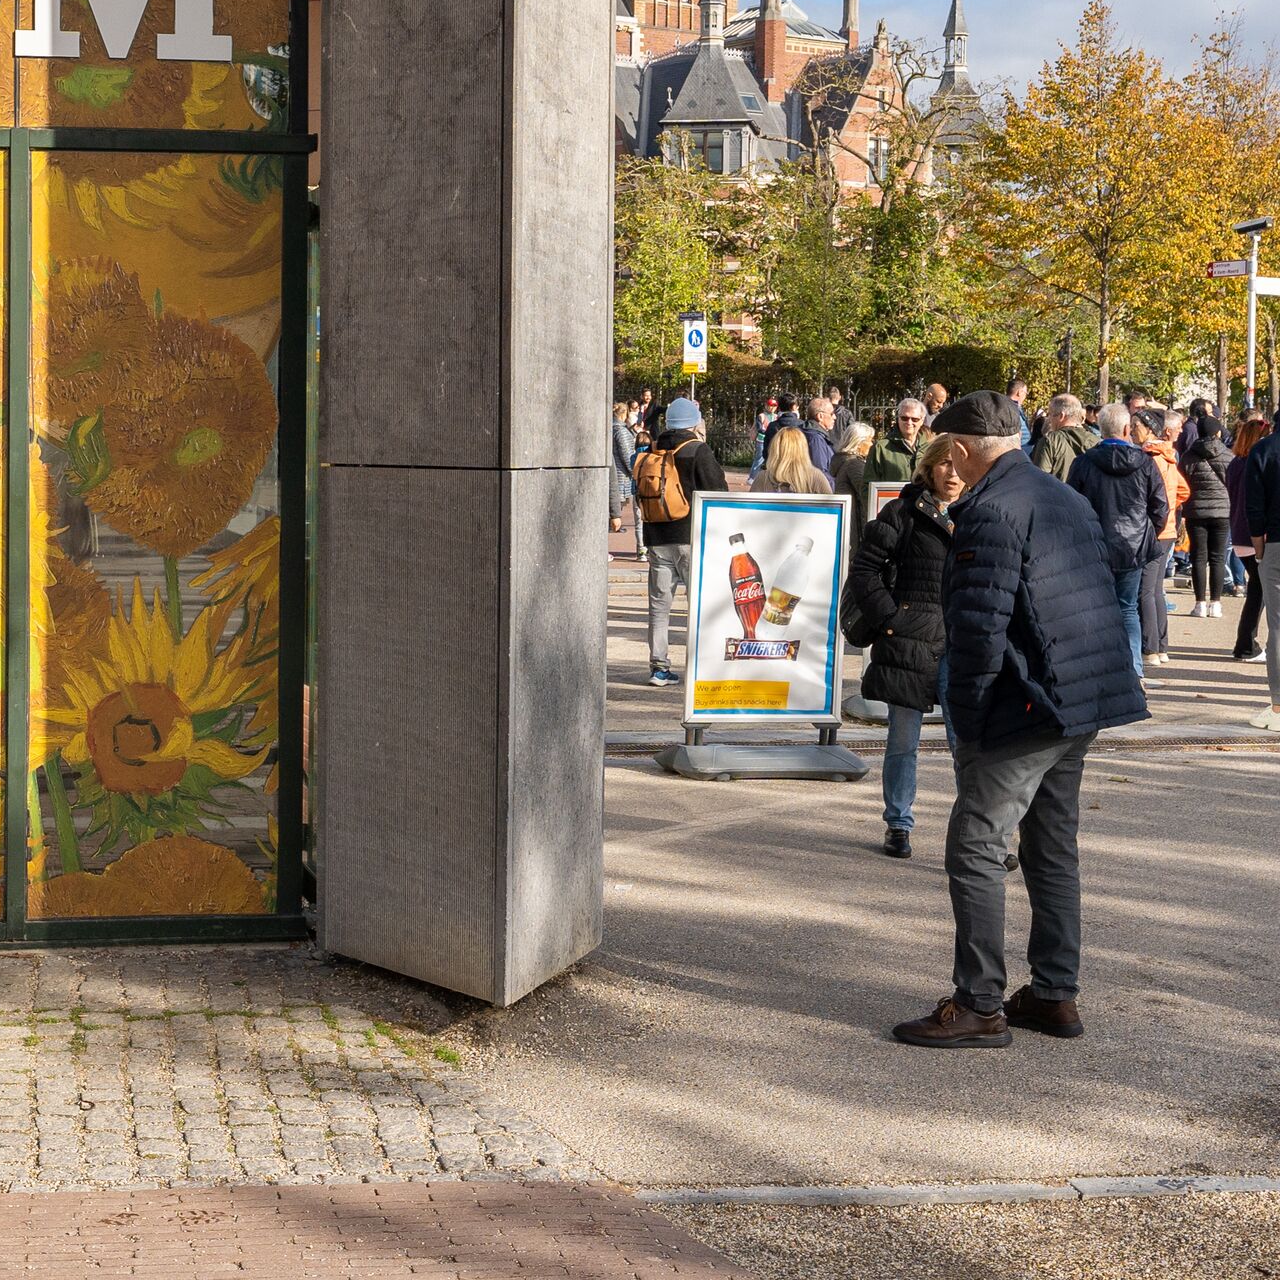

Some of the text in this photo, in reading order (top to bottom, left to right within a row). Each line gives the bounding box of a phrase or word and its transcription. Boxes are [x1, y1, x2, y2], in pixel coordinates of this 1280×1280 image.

[733, 581, 765, 601] oca-Cola
[738, 642, 788, 656] SNICKERS
[722, 685, 742, 693] open
[695, 699, 708, 707] Buy
